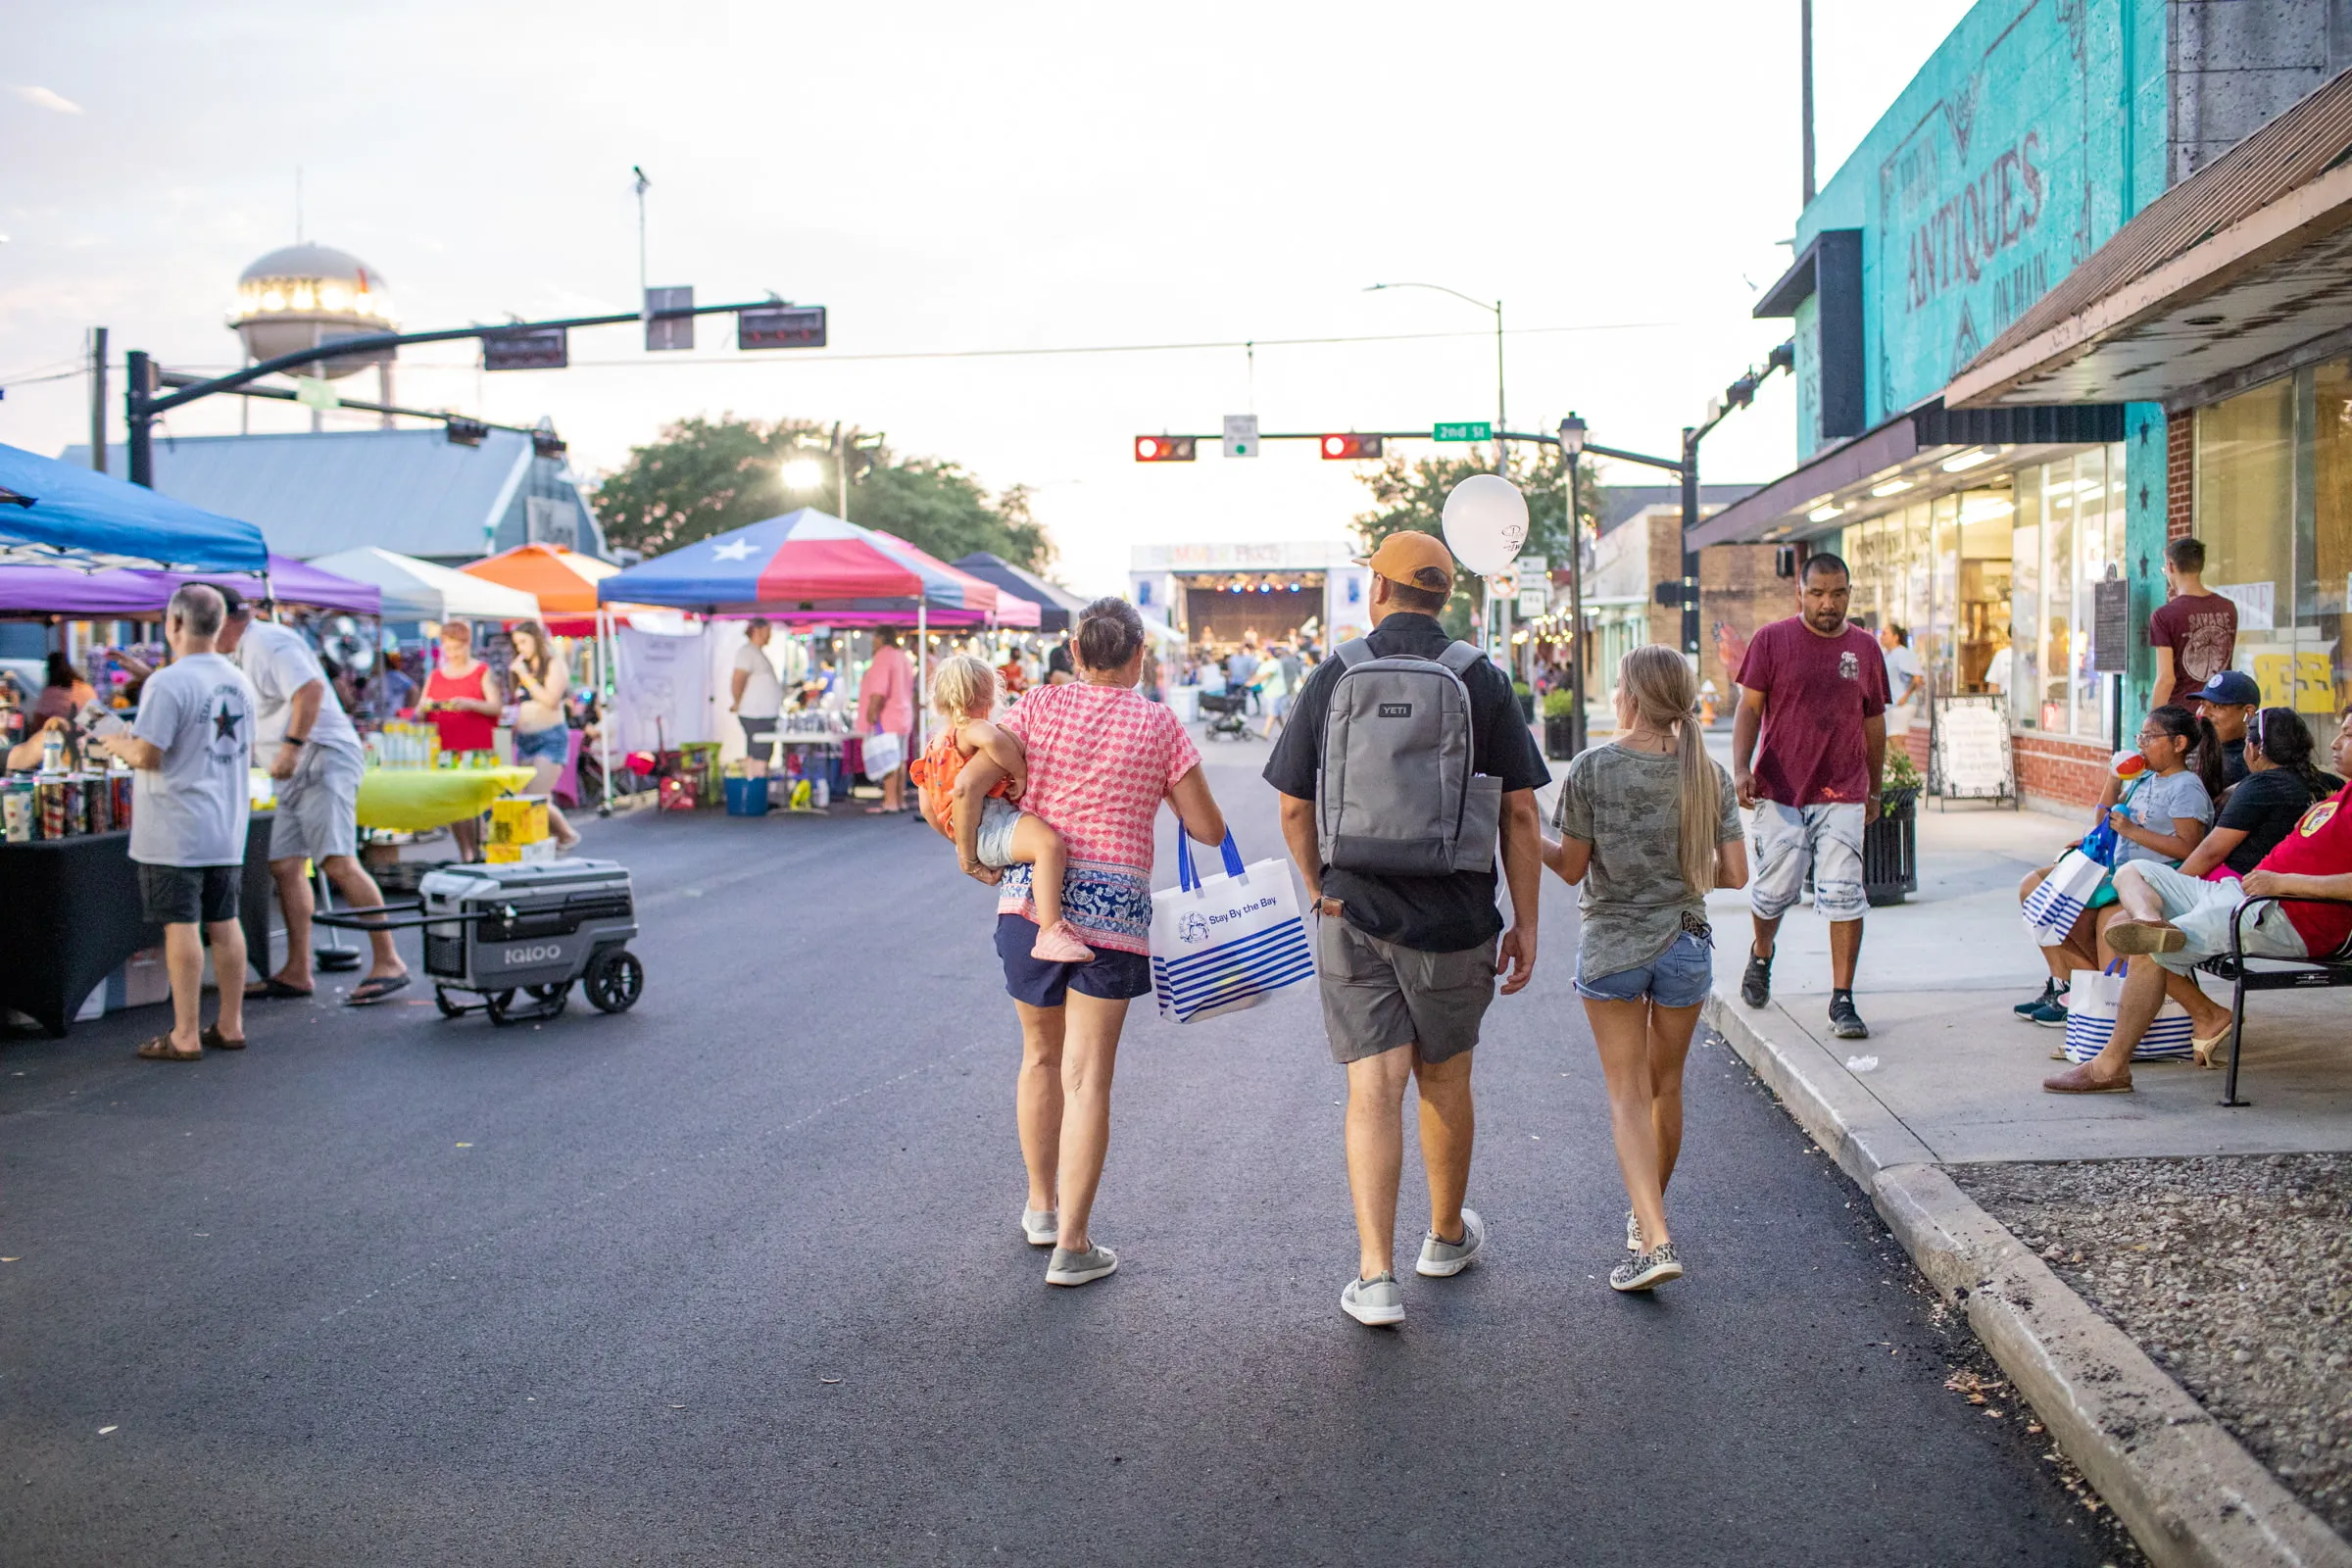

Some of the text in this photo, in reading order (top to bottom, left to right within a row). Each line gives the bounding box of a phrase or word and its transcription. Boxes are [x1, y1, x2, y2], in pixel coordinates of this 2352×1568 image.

[1906, 129, 2041, 315] ANTIQUES
[1440, 425, 1485, 439] 2nd St
[2187, 611, 2231, 631] SAVAGE
[1384, 706, 1407, 714] YETI
[1208, 896, 1277, 925] Stay By the Bay
[505, 944, 562, 965] IGLOO
